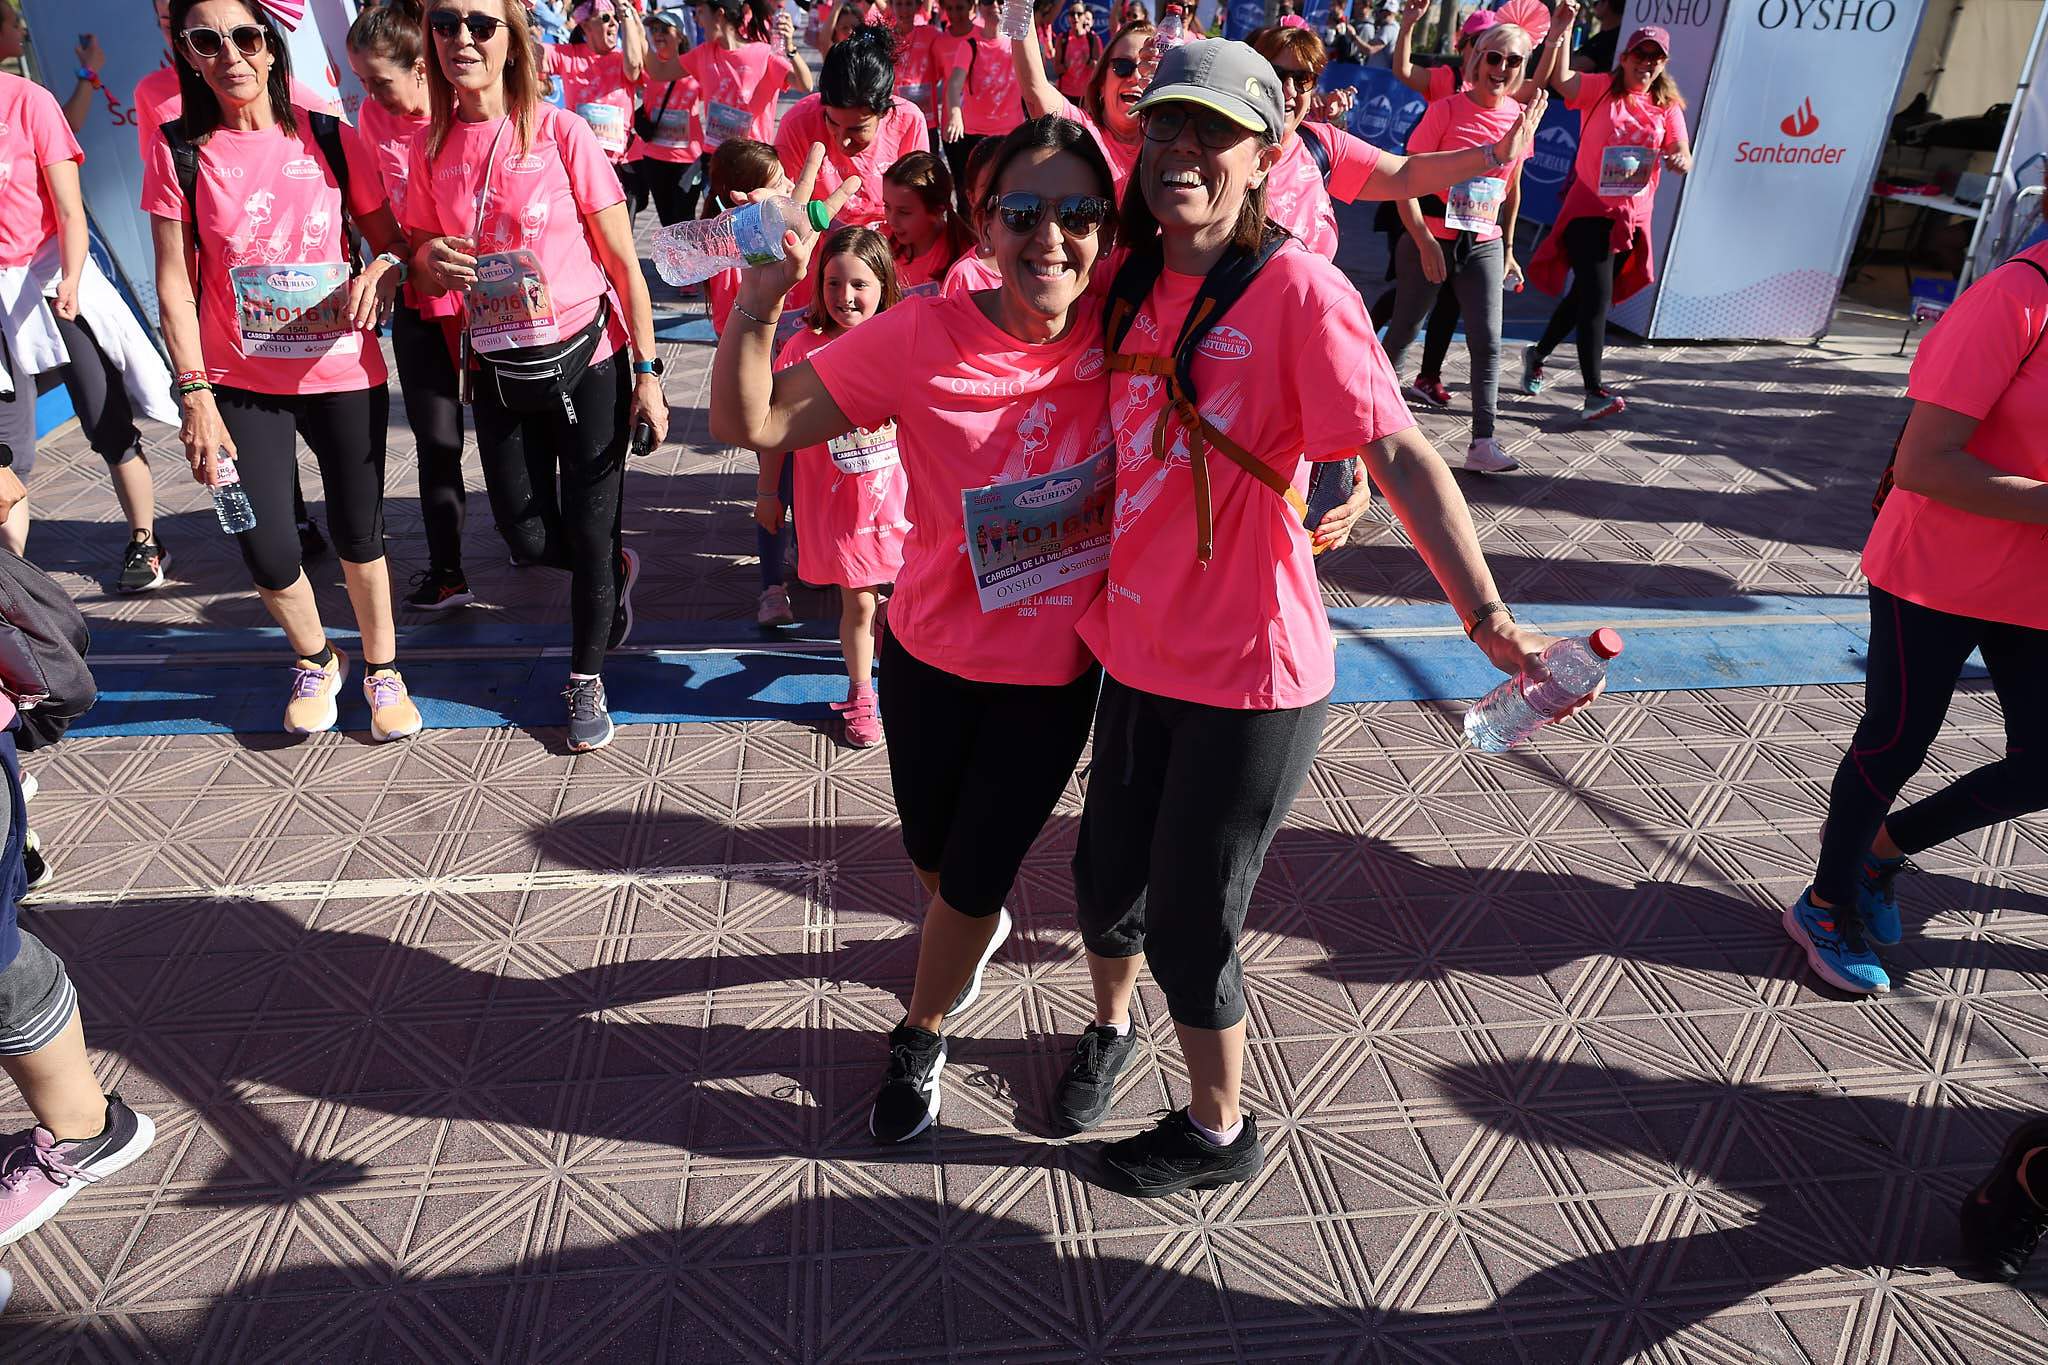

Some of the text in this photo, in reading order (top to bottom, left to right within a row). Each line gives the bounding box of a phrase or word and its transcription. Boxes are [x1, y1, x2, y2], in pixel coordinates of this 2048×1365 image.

[1636, 0, 1711, 27] OYSHO
[1758, 0, 1897, 33] OYSHO
[1735, 142, 1847, 165] Santander
[212, 167, 244, 178] SHO
[271, 274, 315, 287] ASTURIANA
[480, 268, 513, 280] ASTURIANA
[490, 295, 521, 312] 016
[275, 306, 320, 322] 016
[247, 331, 274, 340] CARRERA
[321, 330, 347, 339] VALENCIA
[254, 343, 291, 353] OYSHO
[951, 378, 1025, 397] OYSHO
[837, 450, 861, 459] CARRERA
[877, 443, 893, 452] MUJER
[844, 458, 876, 470] OYSHO
[1018, 484, 1079, 506] ASTURIANA
[1040, 542, 1061, 553] 529
[985, 535, 1111, 584] CARRERA DE LA MUJER VALENC
[1070, 553, 1110, 572] Santande
[997, 573, 1042, 598] OYSHO
[1034, 596, 1044, 606] LA
[1045, 595, 1073, 606] MUJER
[1018, 607, 1038, 617] 2024
